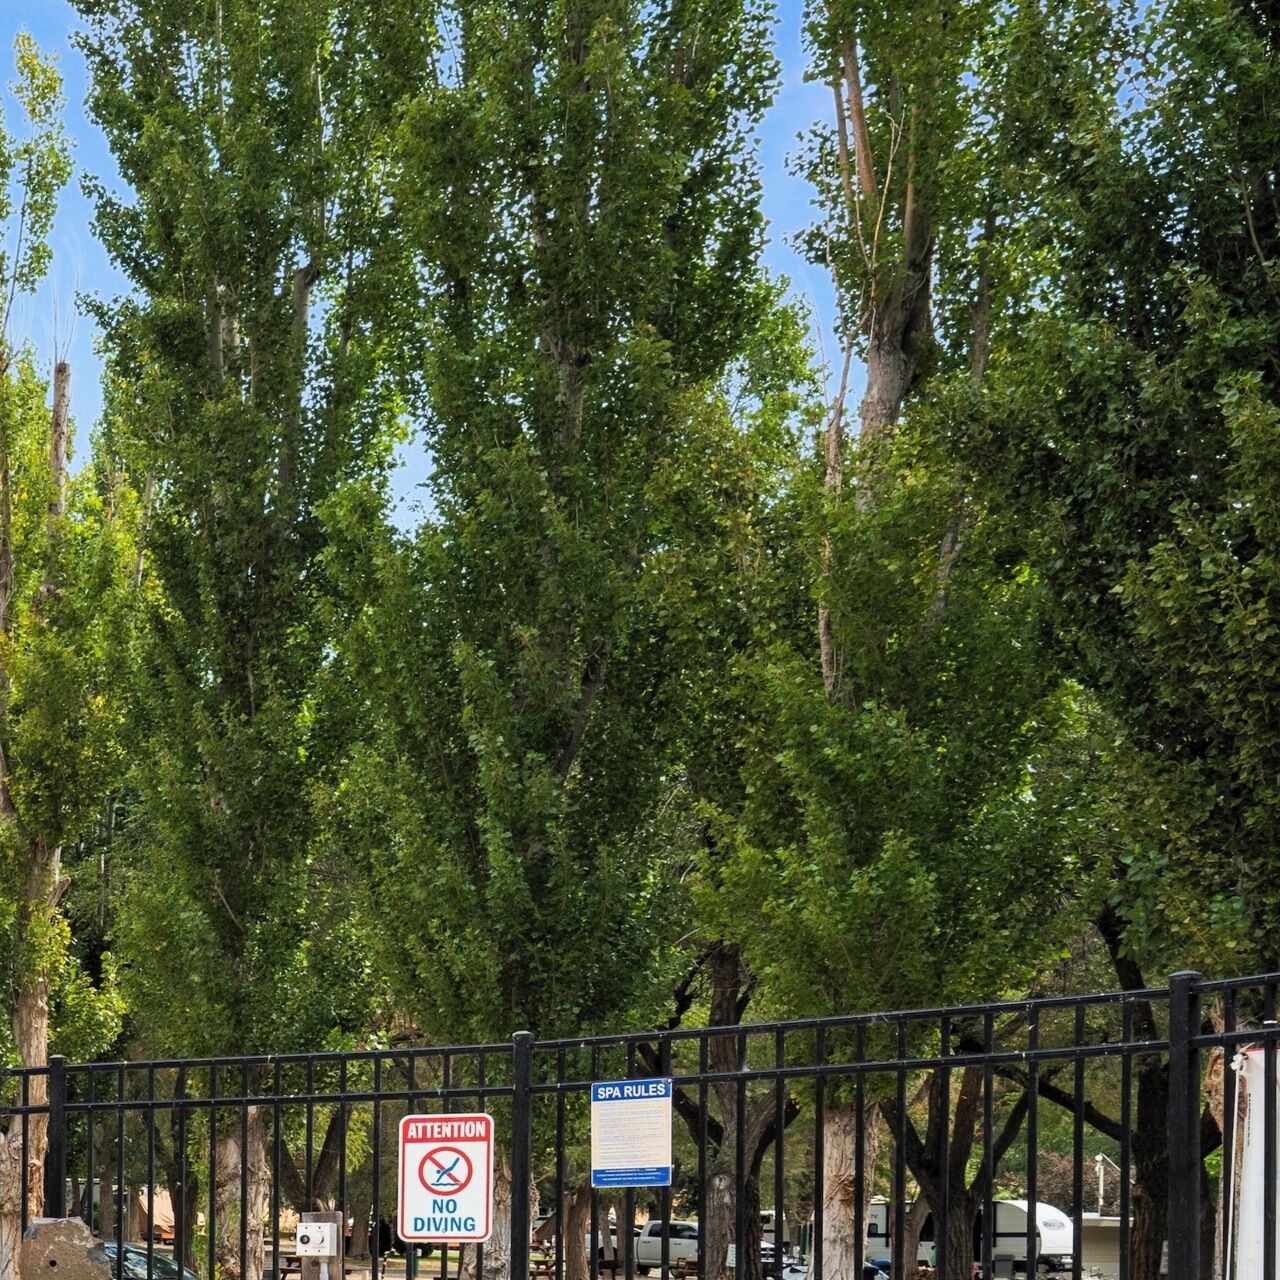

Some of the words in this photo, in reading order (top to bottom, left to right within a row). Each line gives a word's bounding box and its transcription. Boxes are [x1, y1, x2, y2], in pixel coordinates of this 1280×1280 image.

[597, 1087, 622, 1099] SPA
[624, 1083, 666, 1098] RULES
[407, 1120, 486, 1139] ATTENTION
[432, 1198, 458, 1214] NO
[413, 1216, 476, 1232] DIVING
